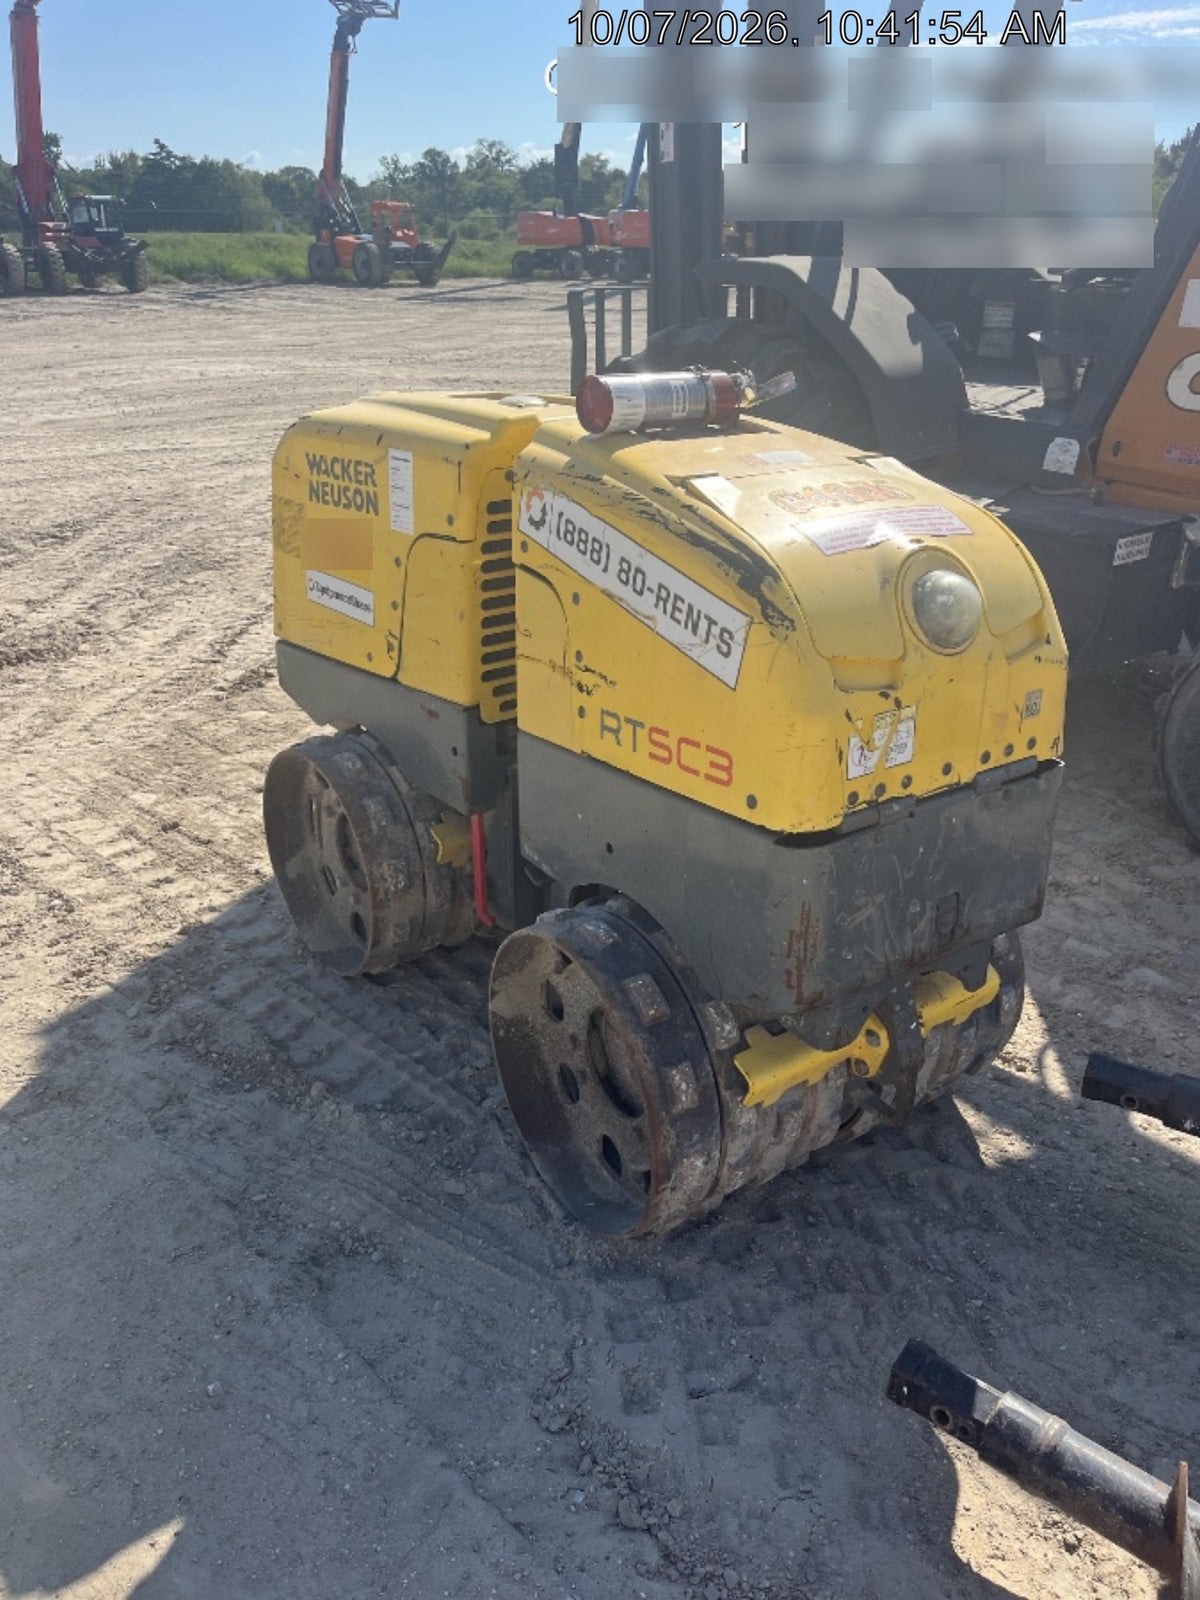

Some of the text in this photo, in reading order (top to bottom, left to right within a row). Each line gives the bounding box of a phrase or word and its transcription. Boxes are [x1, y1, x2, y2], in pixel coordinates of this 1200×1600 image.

[305, 452, 378, 488] WACKER
[309, 480, 379, 516] NEUSON
[556, 511, 735, 659] (888) 80-RENTS
[600, 708, 733, 787] RTSC3
